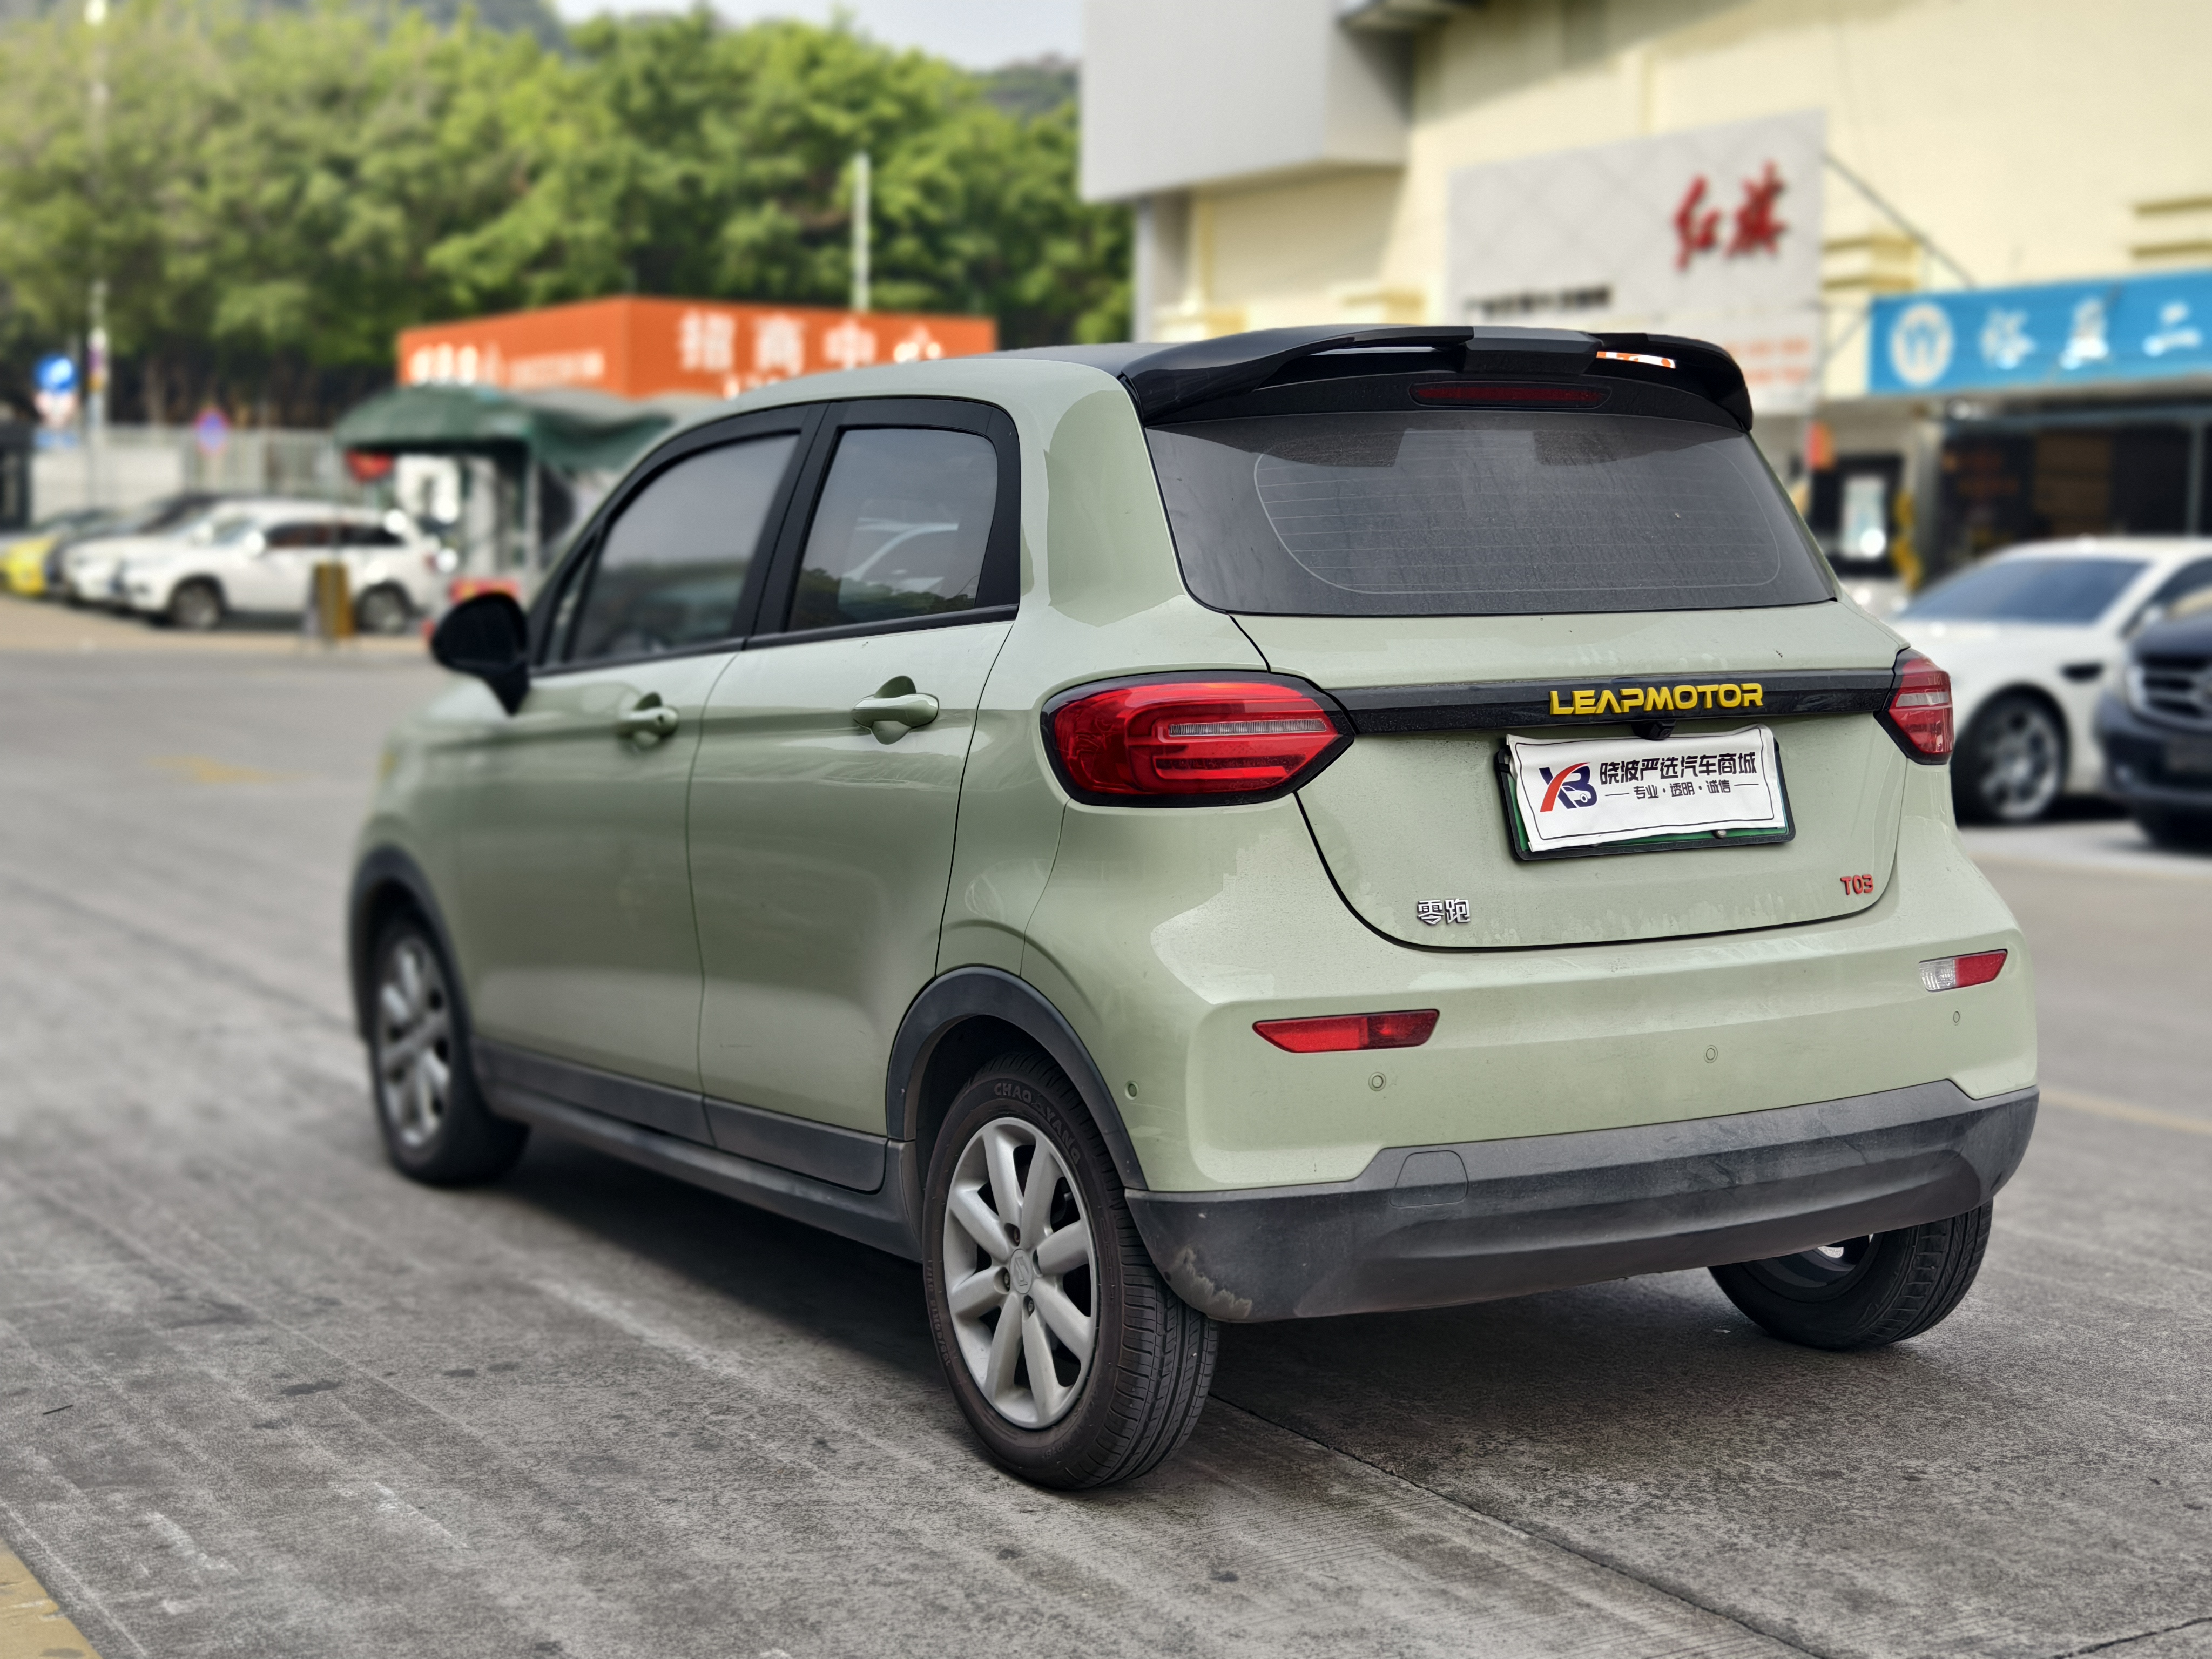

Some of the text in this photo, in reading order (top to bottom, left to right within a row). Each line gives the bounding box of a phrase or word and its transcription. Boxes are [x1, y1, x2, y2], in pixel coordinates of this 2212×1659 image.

[1549, 683, 1763, 715] LEAPMOTOR
[1599, 752, 1757, 785] 晓波严选汽车商城
[1840, 874, 1874, 895] T03
[1417, 898, 1471, 925] 零跑
